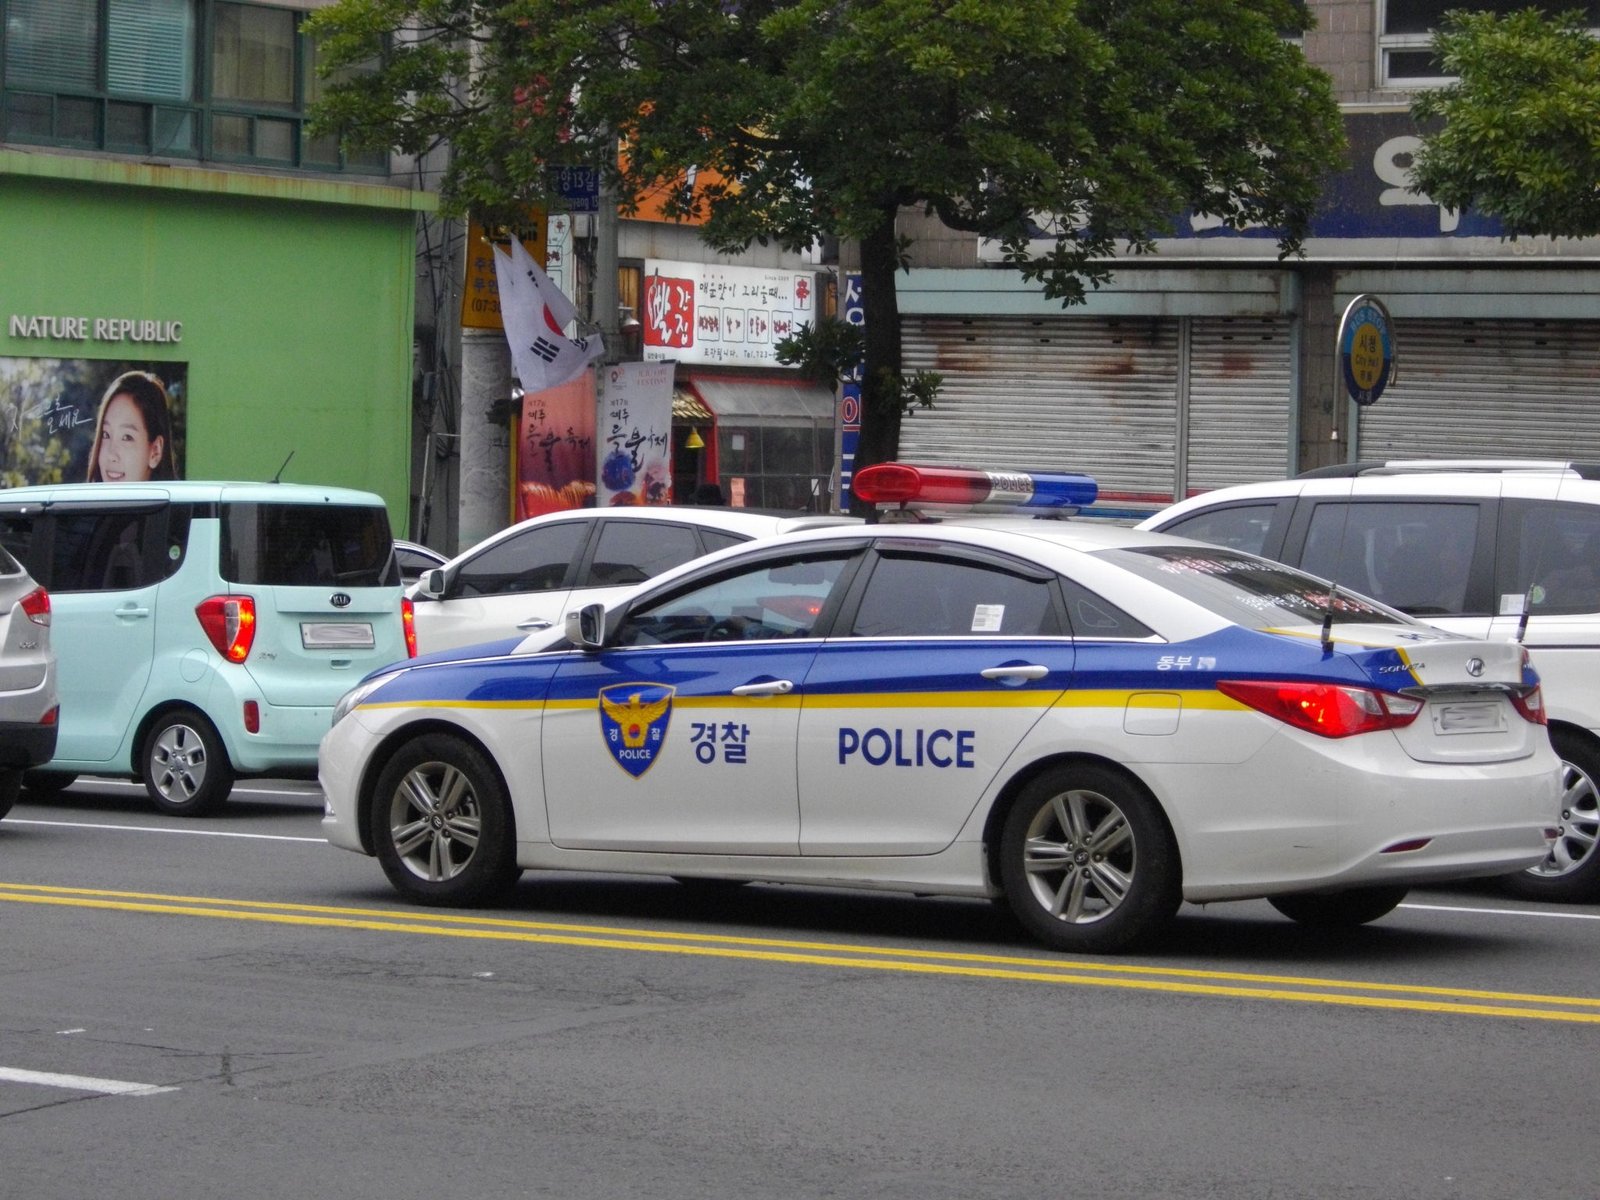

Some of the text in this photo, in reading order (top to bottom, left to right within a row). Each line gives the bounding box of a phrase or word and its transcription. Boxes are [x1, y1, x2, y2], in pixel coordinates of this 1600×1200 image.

[9, 315, 183, 342] NATURE REPUBLIC
[992, 475, 1032, 493] POLICE
[1156, 656, 1192, 671] 동부
[690, 721, 750, 764] 경찰
[838, 727, 976, 769] POLICE
[619, 749, 651, 759] POLICE
